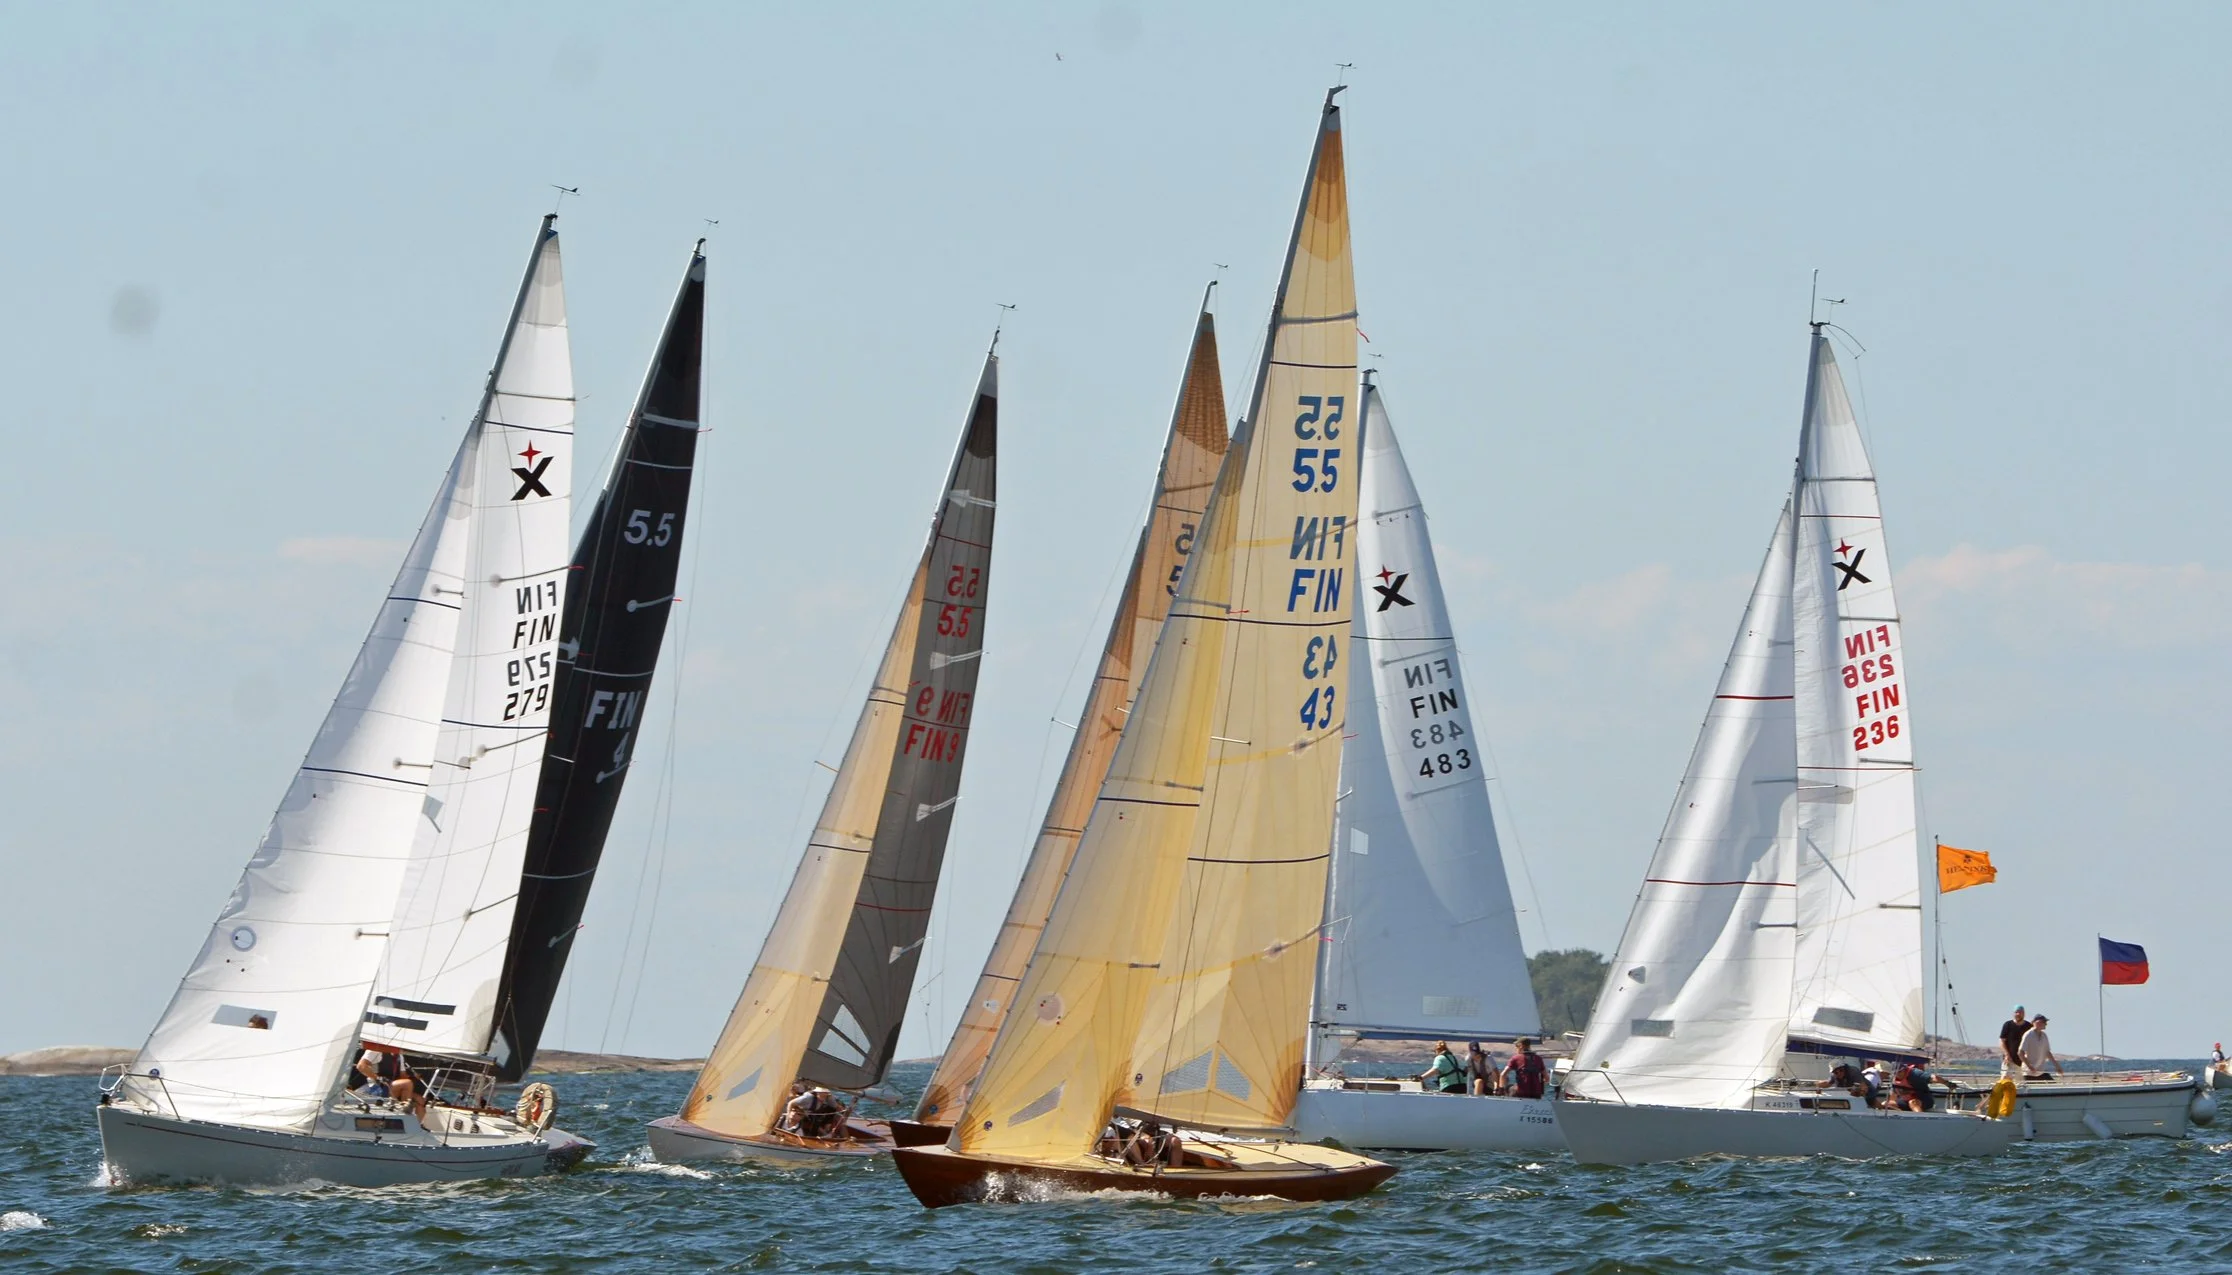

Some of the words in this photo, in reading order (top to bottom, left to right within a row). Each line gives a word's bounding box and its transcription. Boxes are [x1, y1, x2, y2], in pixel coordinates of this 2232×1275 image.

[1291, 448, 1340, 493] 5.5
[624, 509, 674, 547] 5.5
[1287, 567, 1342, 612] FIN
[512, 614, 556, 649] FIN
[937, 604, 972, 638] 5.5
[503, 683, 549, 721] 279
[584, 690, 643, 729] FIN
[1299, 686, 1335, 731] 43
[1410, 688, 1459, 719] FIN
[1856, 684, 1900, 718] FIN
[904, 724, 946, 761] FIN
[1853, 715, 1900, 751] 236
[1419, 748, 1472, 779] 483
